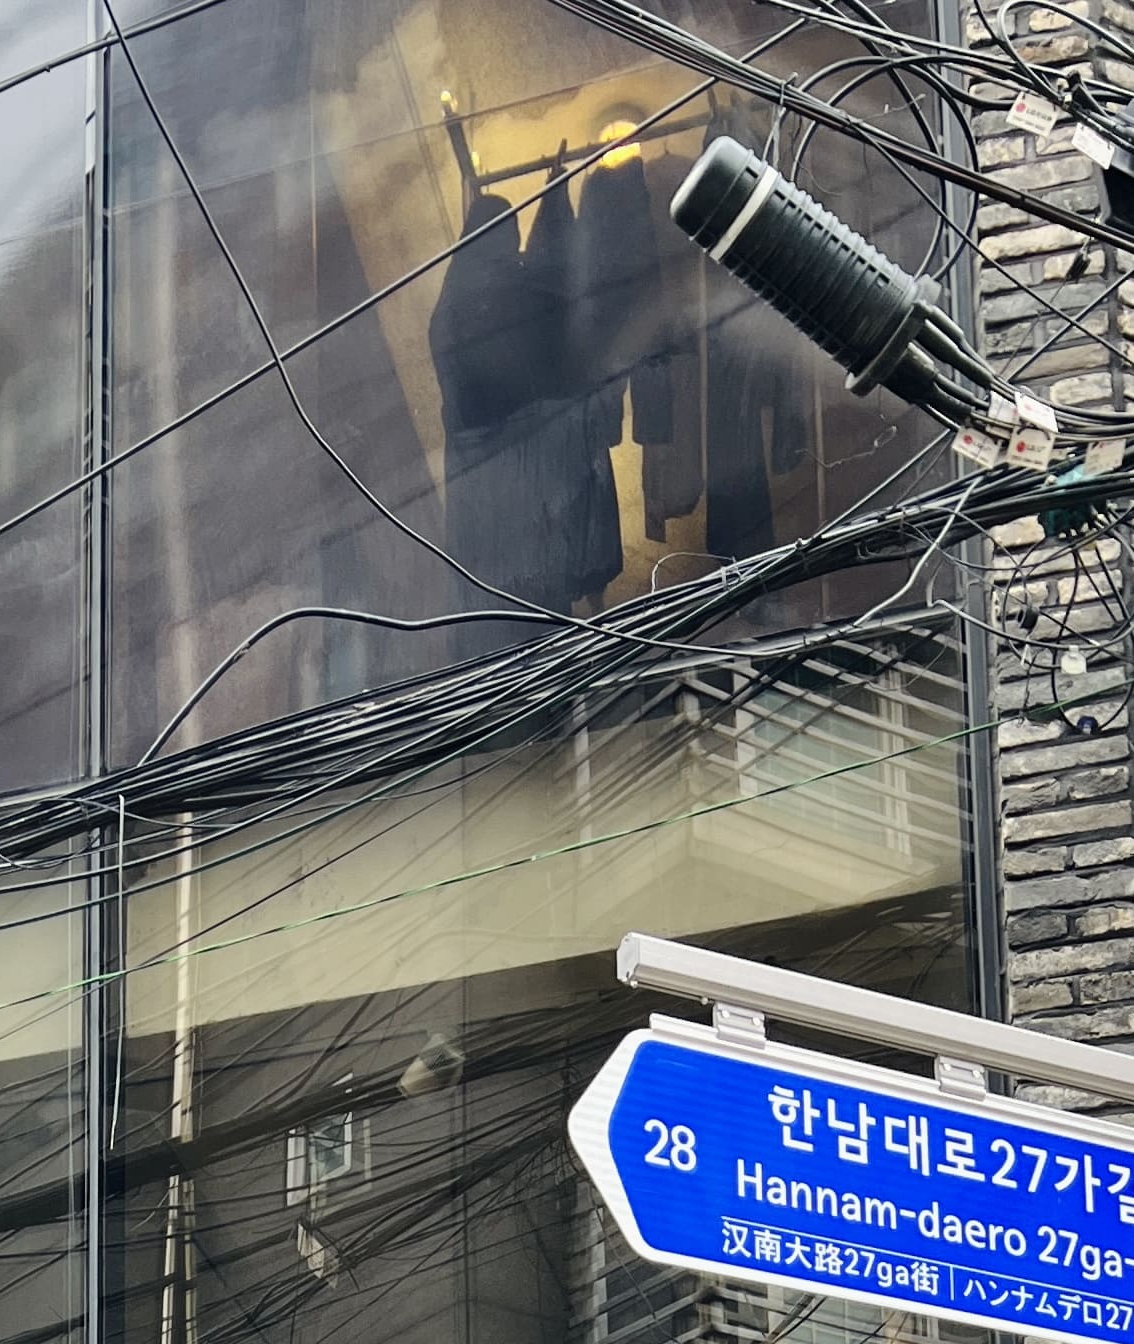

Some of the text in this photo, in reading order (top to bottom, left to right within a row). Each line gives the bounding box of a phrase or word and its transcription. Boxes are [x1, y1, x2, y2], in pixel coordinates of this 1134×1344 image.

[644, 1119, 697, 1172] 28
[737, 1158, 1027, 1257] Hannam-daero
[721, 1221, 939, 1295] 汉南大路27ga街
